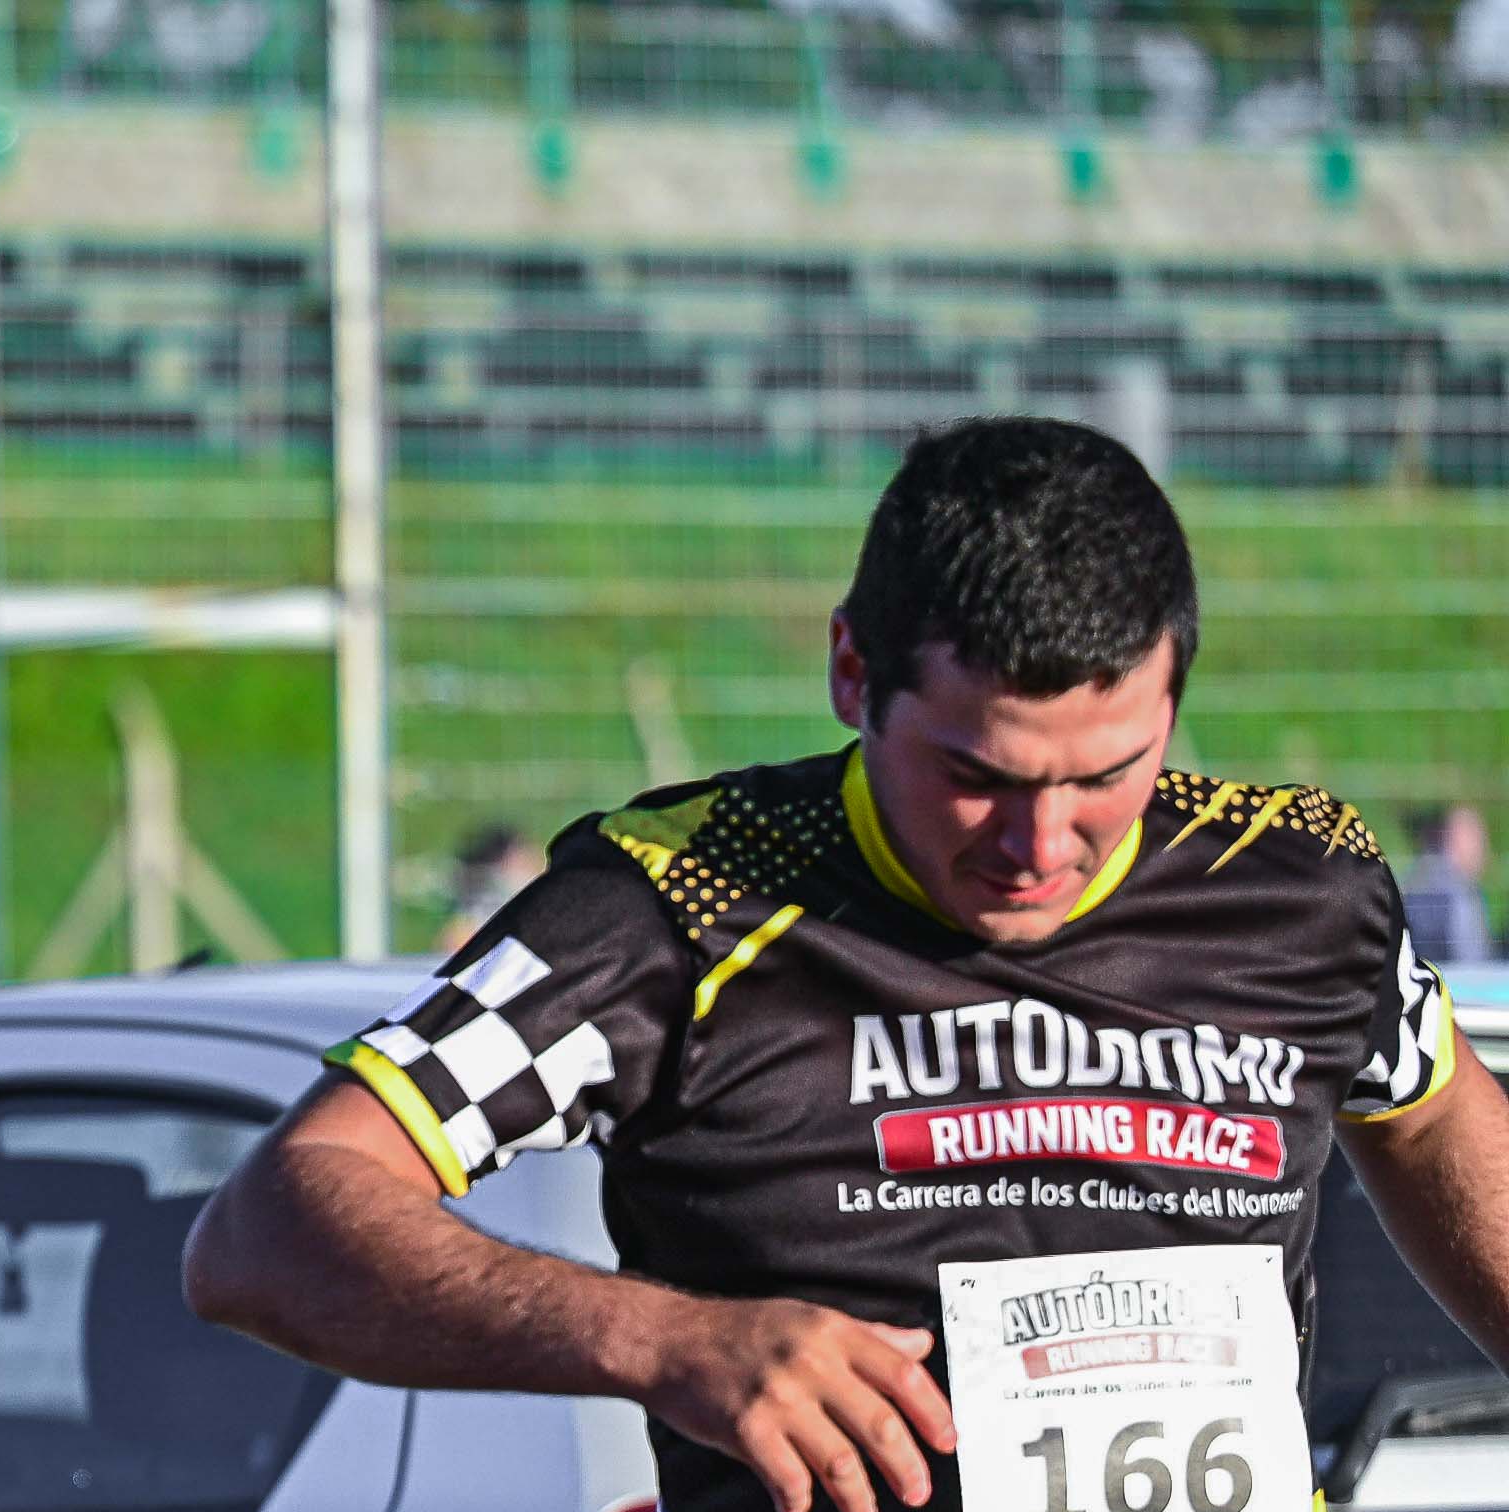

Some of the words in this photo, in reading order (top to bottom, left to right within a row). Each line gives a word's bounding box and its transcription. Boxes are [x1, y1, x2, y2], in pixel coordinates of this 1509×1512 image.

[927, 1104, 1134, 1167] RUNNING
[1145, 1108, 1256, 1169] RACE
[837, 1182, 872, 1213] La
[876, 1179, 982, 1212] Carrera
[987, 1176, 1025, 1207] de
[1031, 1177, 1073, 1208] los
[1080, 1178, 1179, 1215] Clubes
[1183, 1186, 1224, 1218] del
